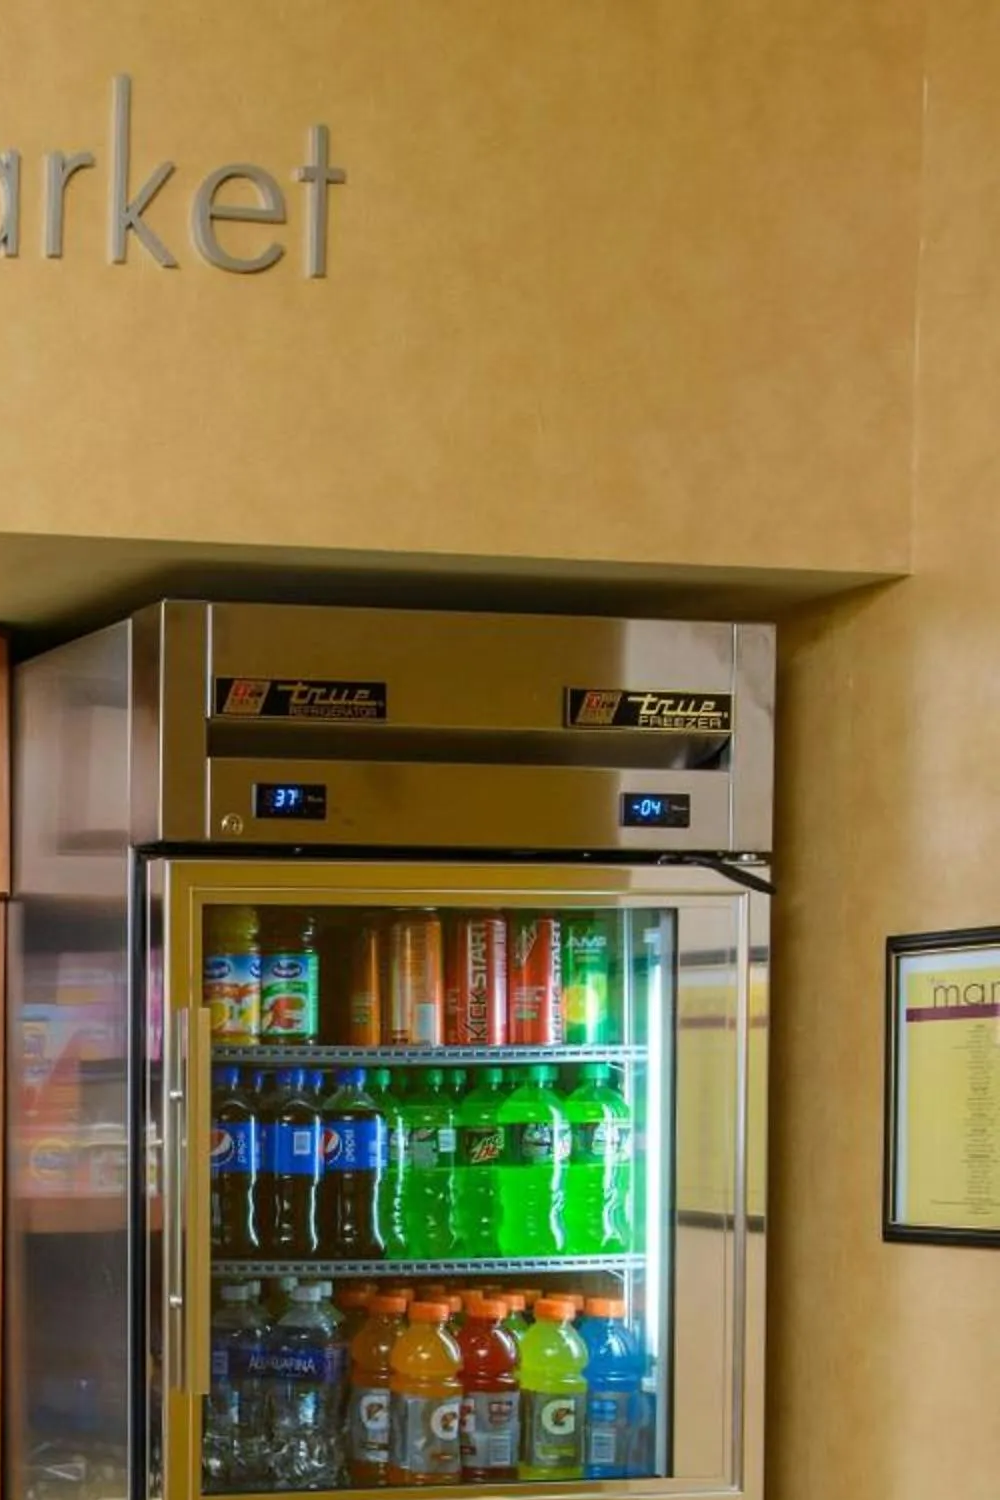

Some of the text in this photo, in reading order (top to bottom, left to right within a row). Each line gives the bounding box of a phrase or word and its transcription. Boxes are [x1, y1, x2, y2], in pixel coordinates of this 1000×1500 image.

[627, 694, 723, 717] true
[637, 715, 722, 729] FREEZER
[274, 788, 297, 807] 37
